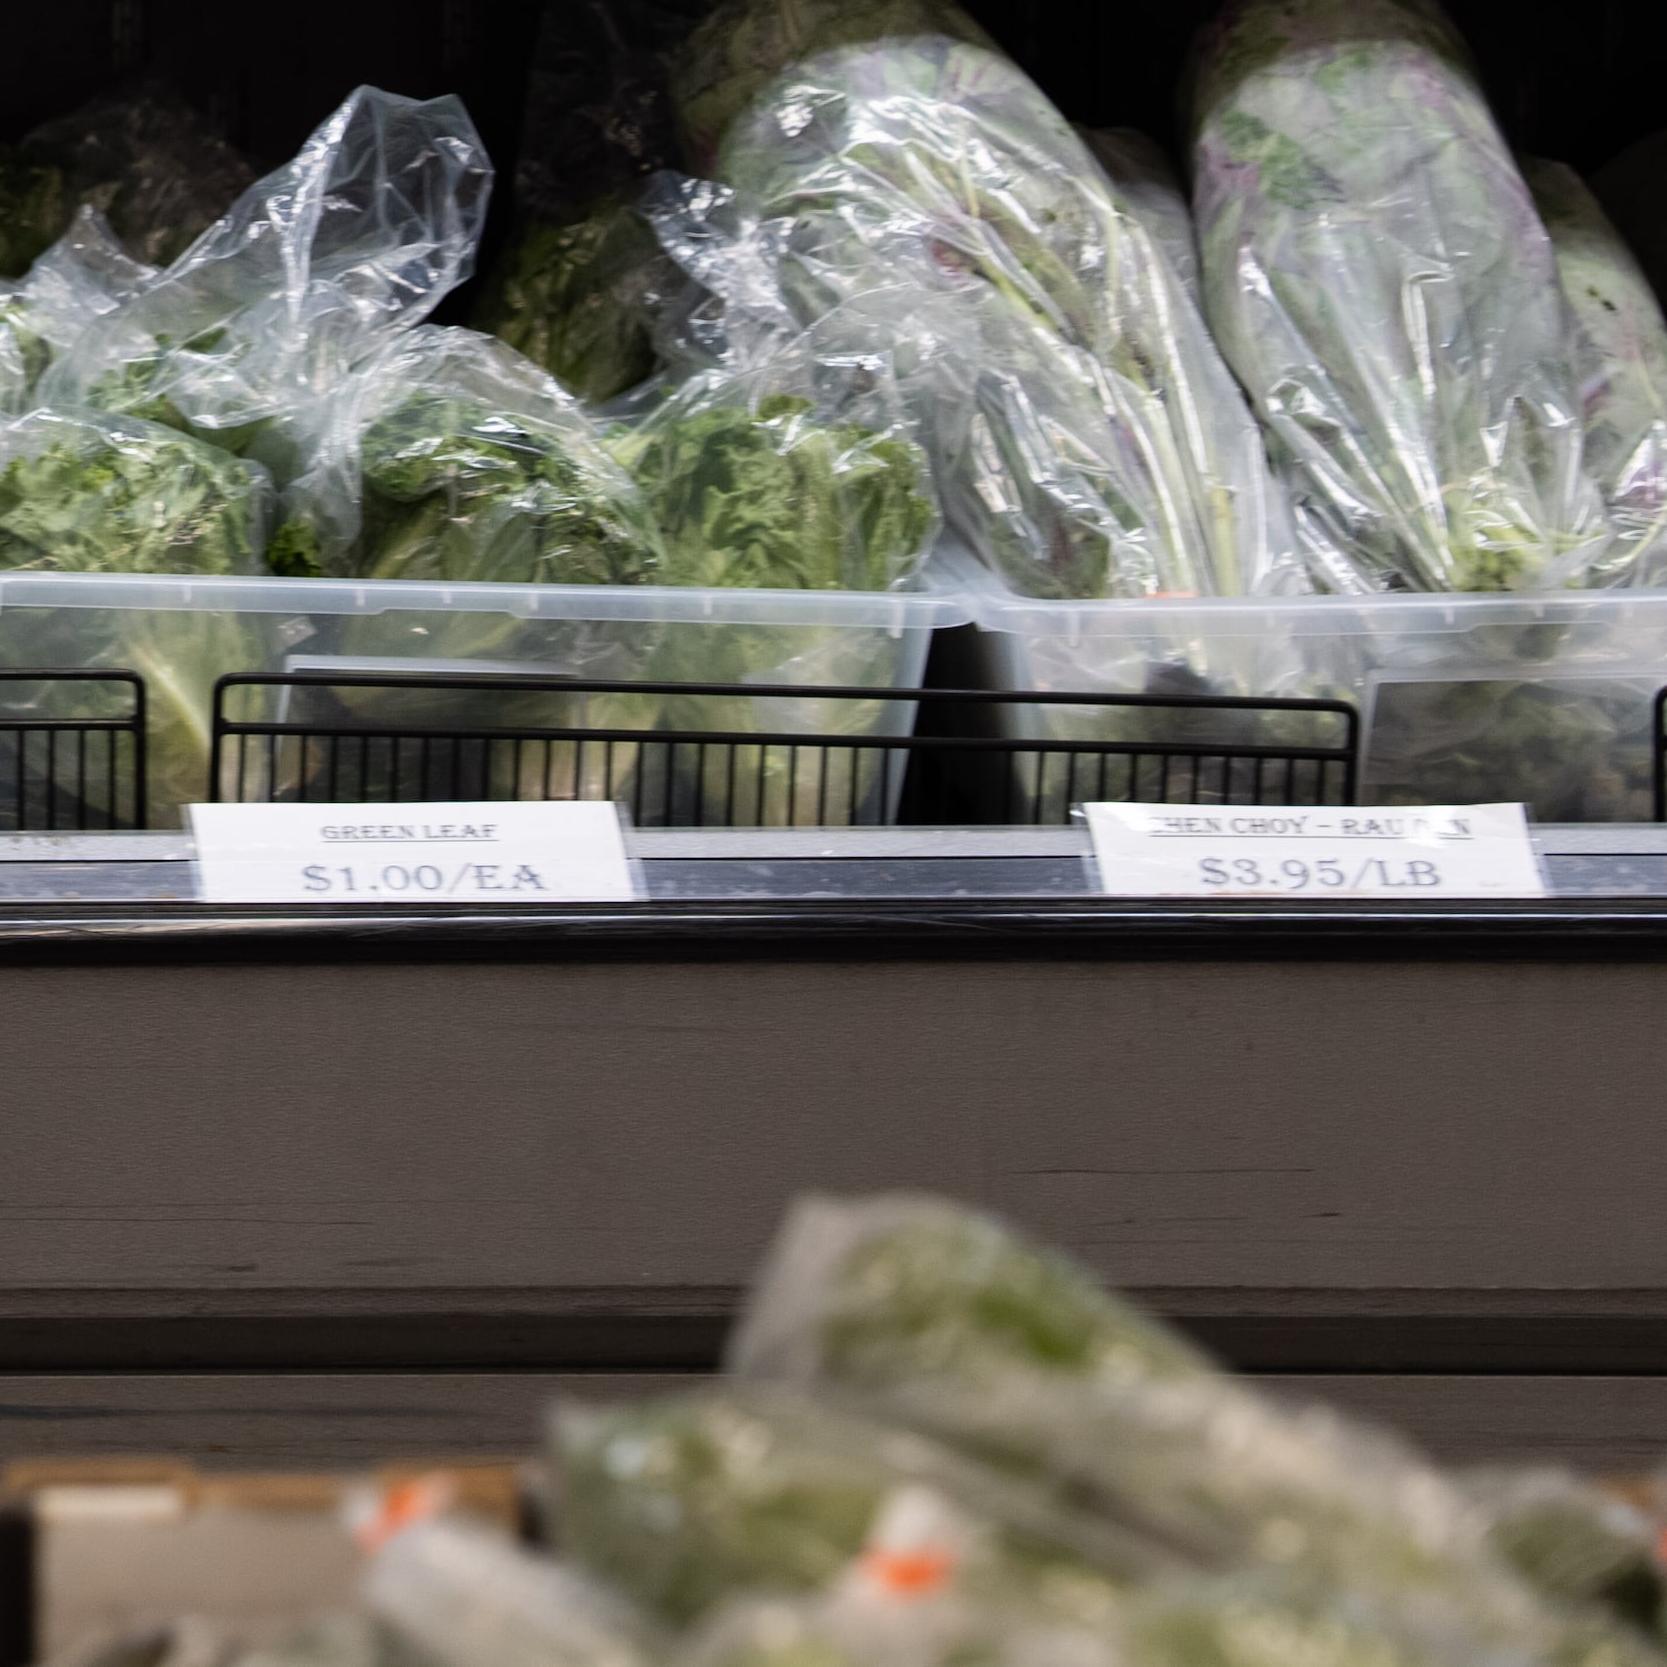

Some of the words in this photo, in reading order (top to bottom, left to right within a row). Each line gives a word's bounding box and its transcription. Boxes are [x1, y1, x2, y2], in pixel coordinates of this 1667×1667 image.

[320, 823, 415, 840] GREEN
[422, 823, 500, 839] LEAF
[1231, 815, 1310, 835] CHOY
[302, 863, 547, 893] $1.00/EA
[1198, 855, 1442, 890] $3.95/LB
